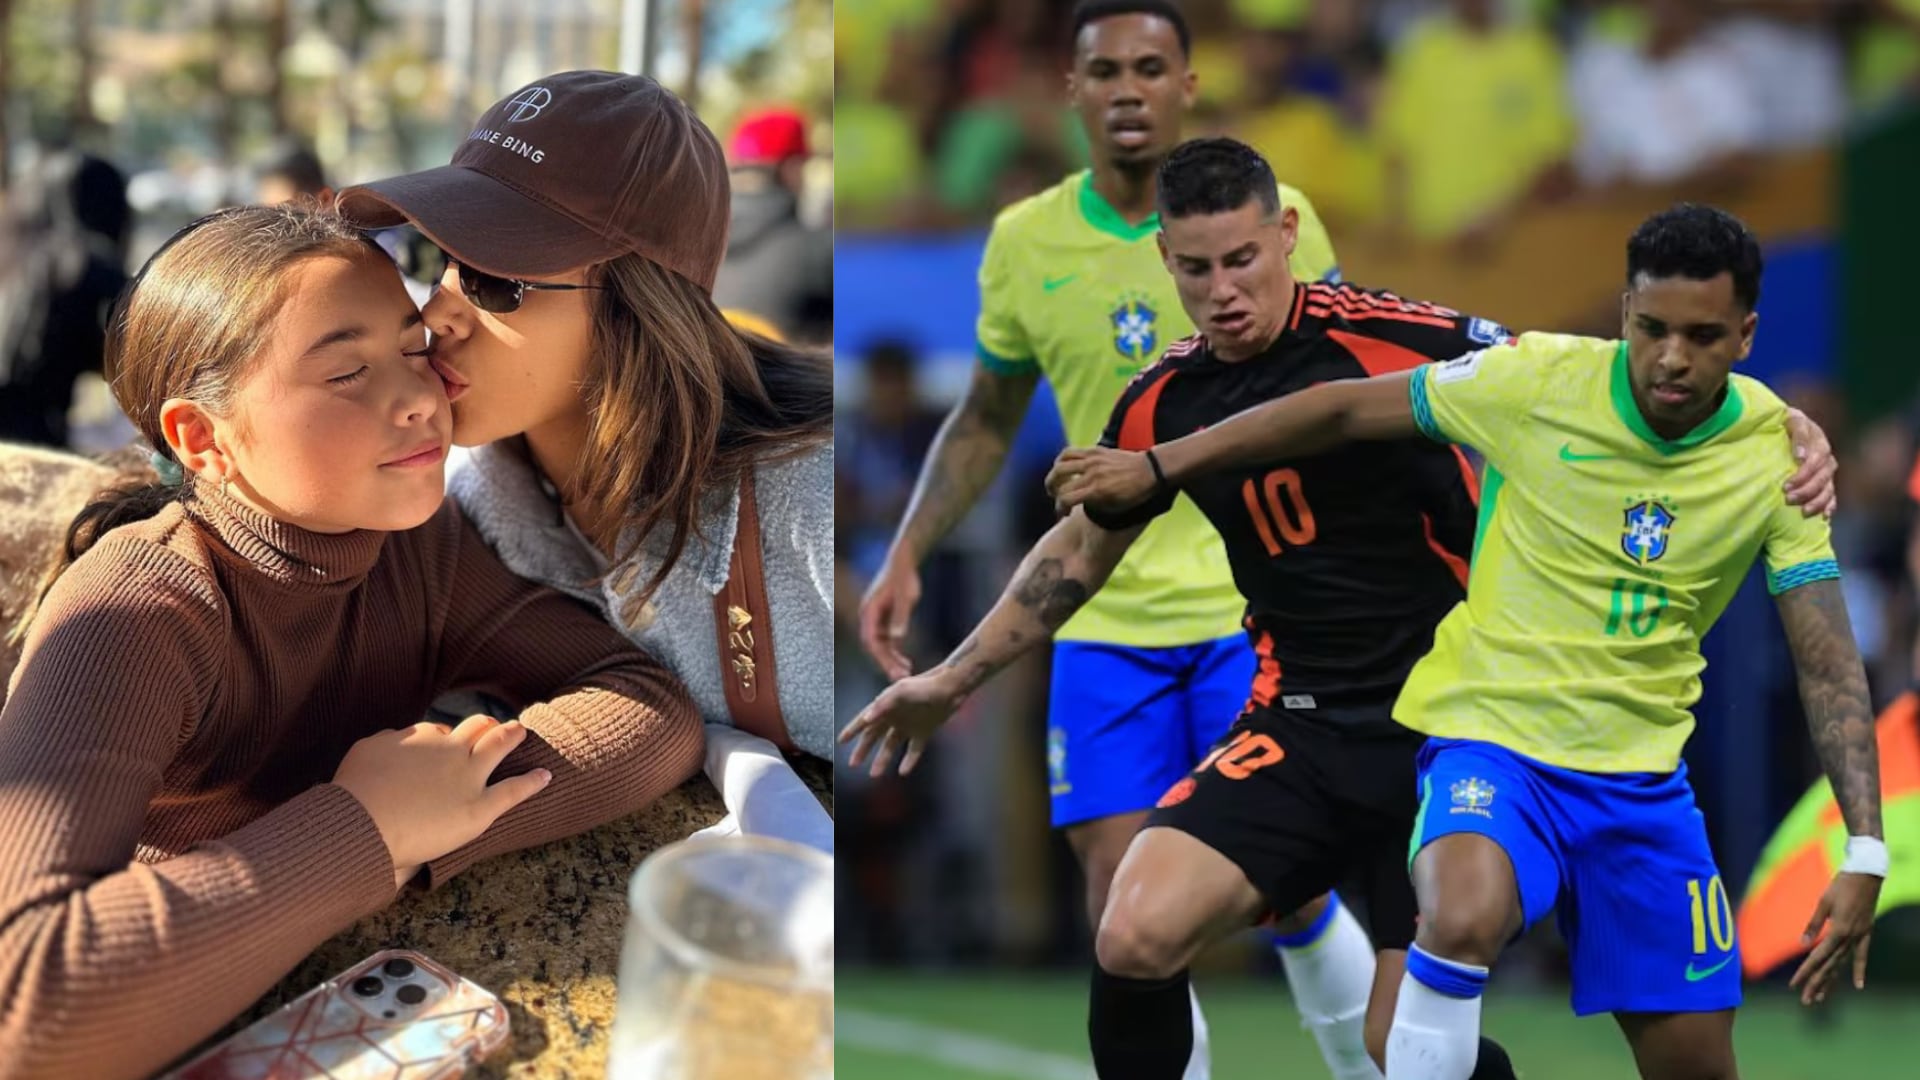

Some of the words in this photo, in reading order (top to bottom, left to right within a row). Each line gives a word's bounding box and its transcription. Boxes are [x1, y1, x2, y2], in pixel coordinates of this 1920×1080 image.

[501, 135, 545, 164] BING
[1242, 467, 1316, 557] 10
[1605, 577, 1669, 639] 10
[1194, 730, 1286, 781] 10
[1687, 875, 1734, 954] 10
